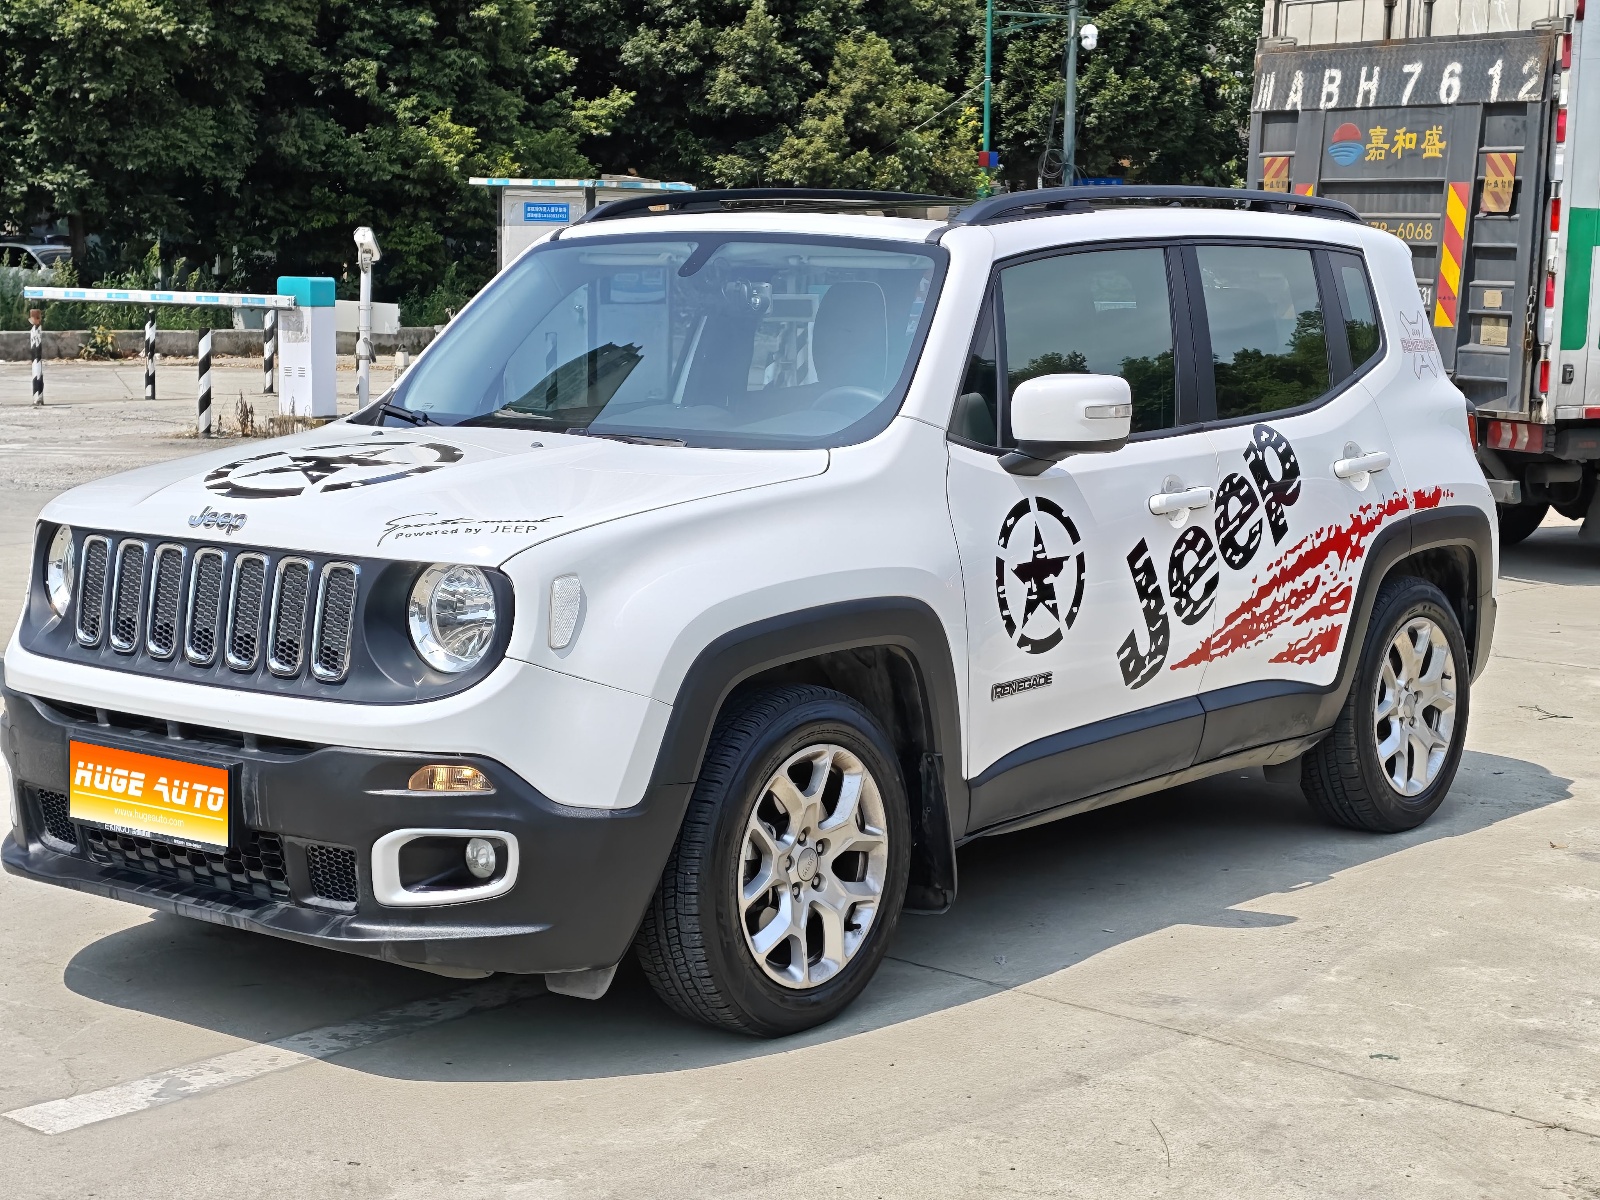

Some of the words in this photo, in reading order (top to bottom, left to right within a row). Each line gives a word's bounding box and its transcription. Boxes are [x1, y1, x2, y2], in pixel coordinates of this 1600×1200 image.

[1365, 124, 1447, 161] 嘉和盛
[187, 505, 249, 536] Jeep
[394, 528, 459, 540] Powered
[464, 527, 482, 535] by
[491, 525, 538, 534] JEEP
[1116, 423, 1302, 690] Jeep
[991, 671, 1053, 701] RENEGADE
